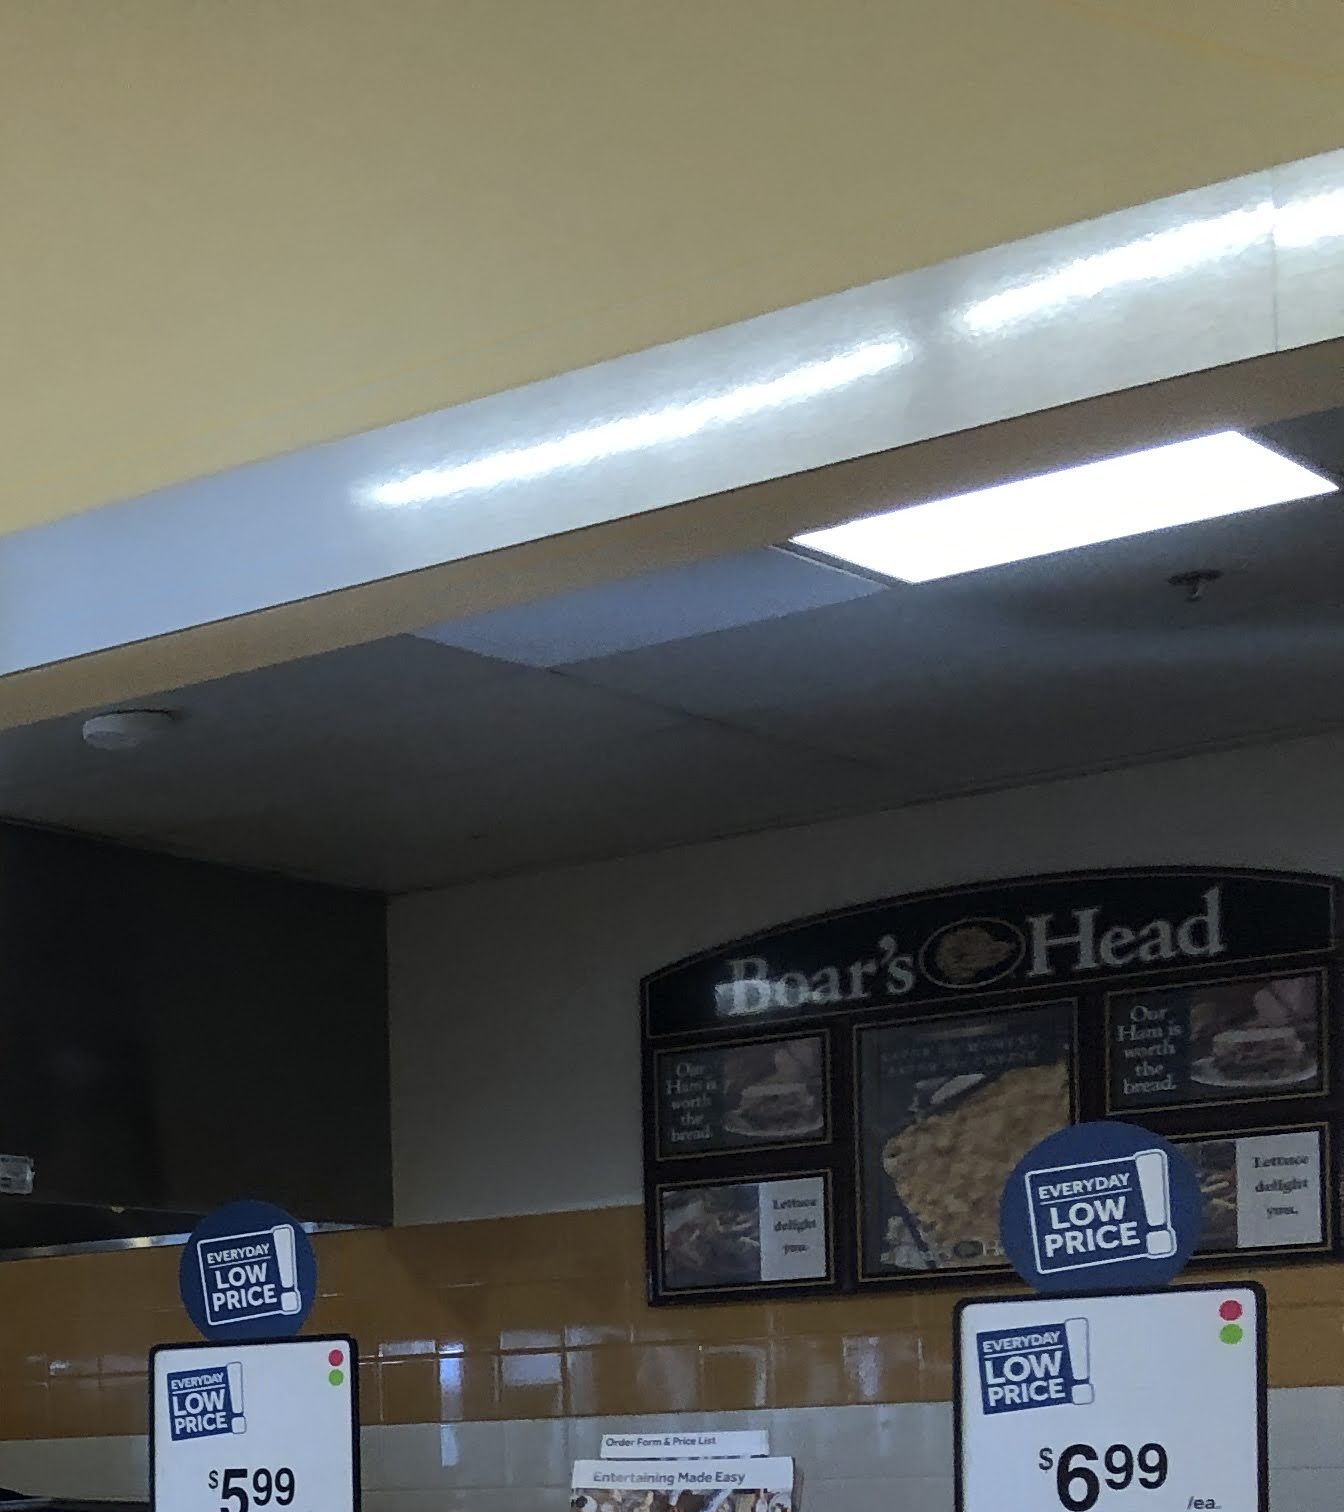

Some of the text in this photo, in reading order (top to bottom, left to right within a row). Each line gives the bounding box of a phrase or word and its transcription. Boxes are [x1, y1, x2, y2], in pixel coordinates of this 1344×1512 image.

[730, 887, 1227, 1016] Boar's Head
[1038, 1172, 1131, 1200] EVERYDAY
[1050, 1197, 1127, 1229] LOW
[206, 1242, 271, 1264] EVERYDAY
[1044, 1221, 1141, 1259] PRICE
[214, 1262, 268, 1291] LOW
[212, 1284, 278, 1312] PRICE
[982, 1330, 1062, 1353] EVERYDAY
[171, 1372, 225, 1390] EVERYDAY
[984, 1350, 1063, 1385] LOW
[172, 1389, 225, 1417] LOW
[987, 1378, 1066, 1407] PRICE
[175, 1412, 228, 1435] PRICE
[605, 1438, 634, 1447] Order
[637, 1437, 662, 1447] Form
[673, 1437, 697, 1446] Price
[698, 1436, 716, 1445] List
[593, 1471, 745, 1485] Entertaining Made Easy
